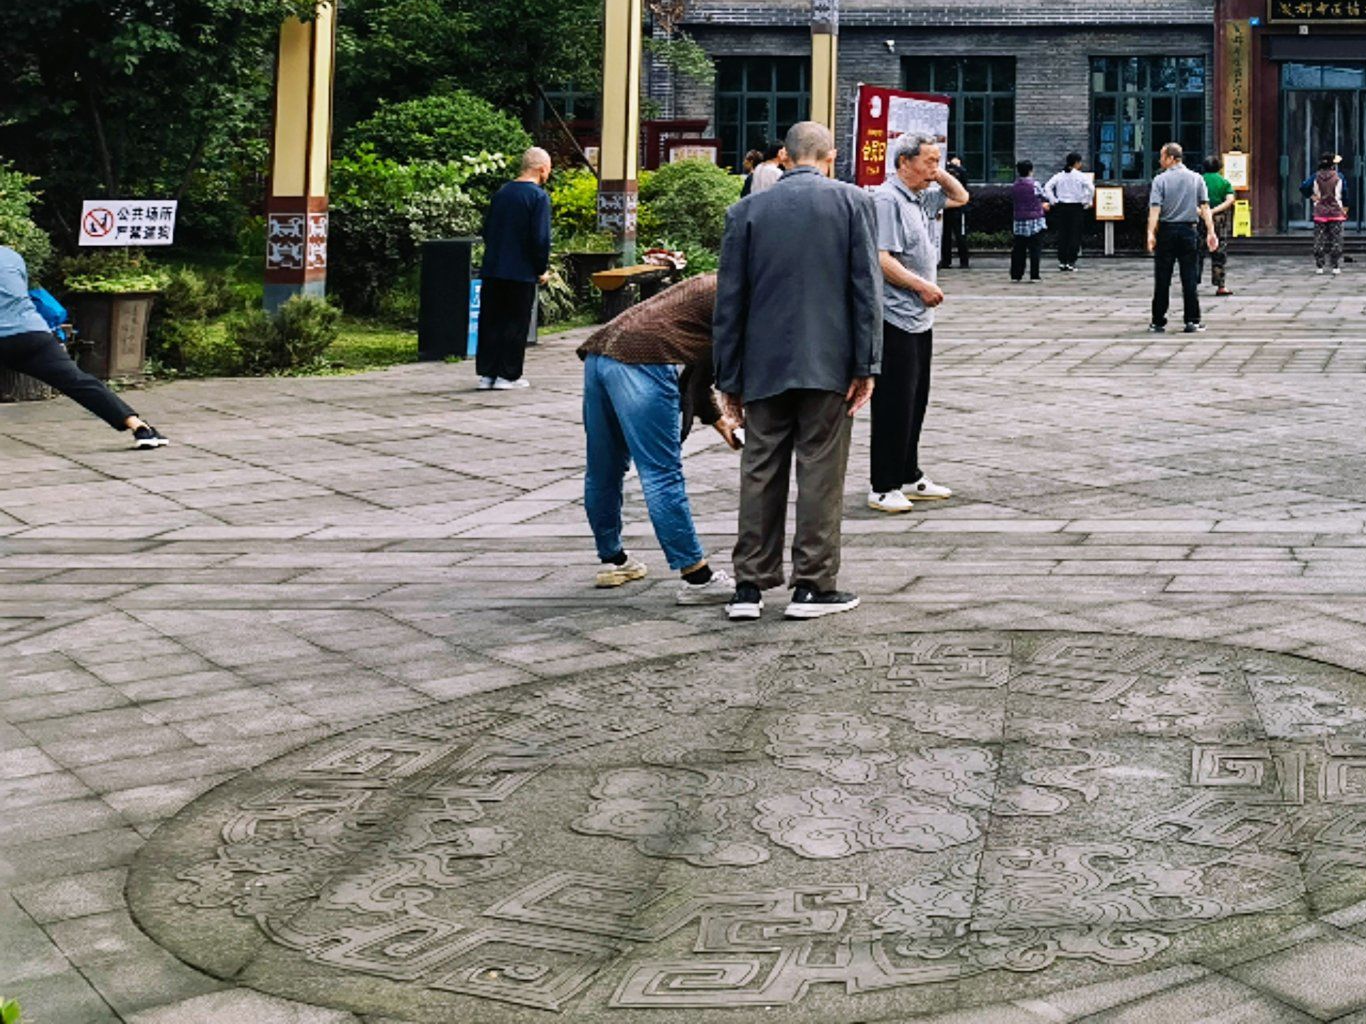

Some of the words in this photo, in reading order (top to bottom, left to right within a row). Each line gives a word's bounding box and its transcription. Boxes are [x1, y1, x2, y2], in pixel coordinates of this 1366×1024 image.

[117, 206, 173, 221] 公共场所
[115, 225, 171, 240] 严禁遛狗
